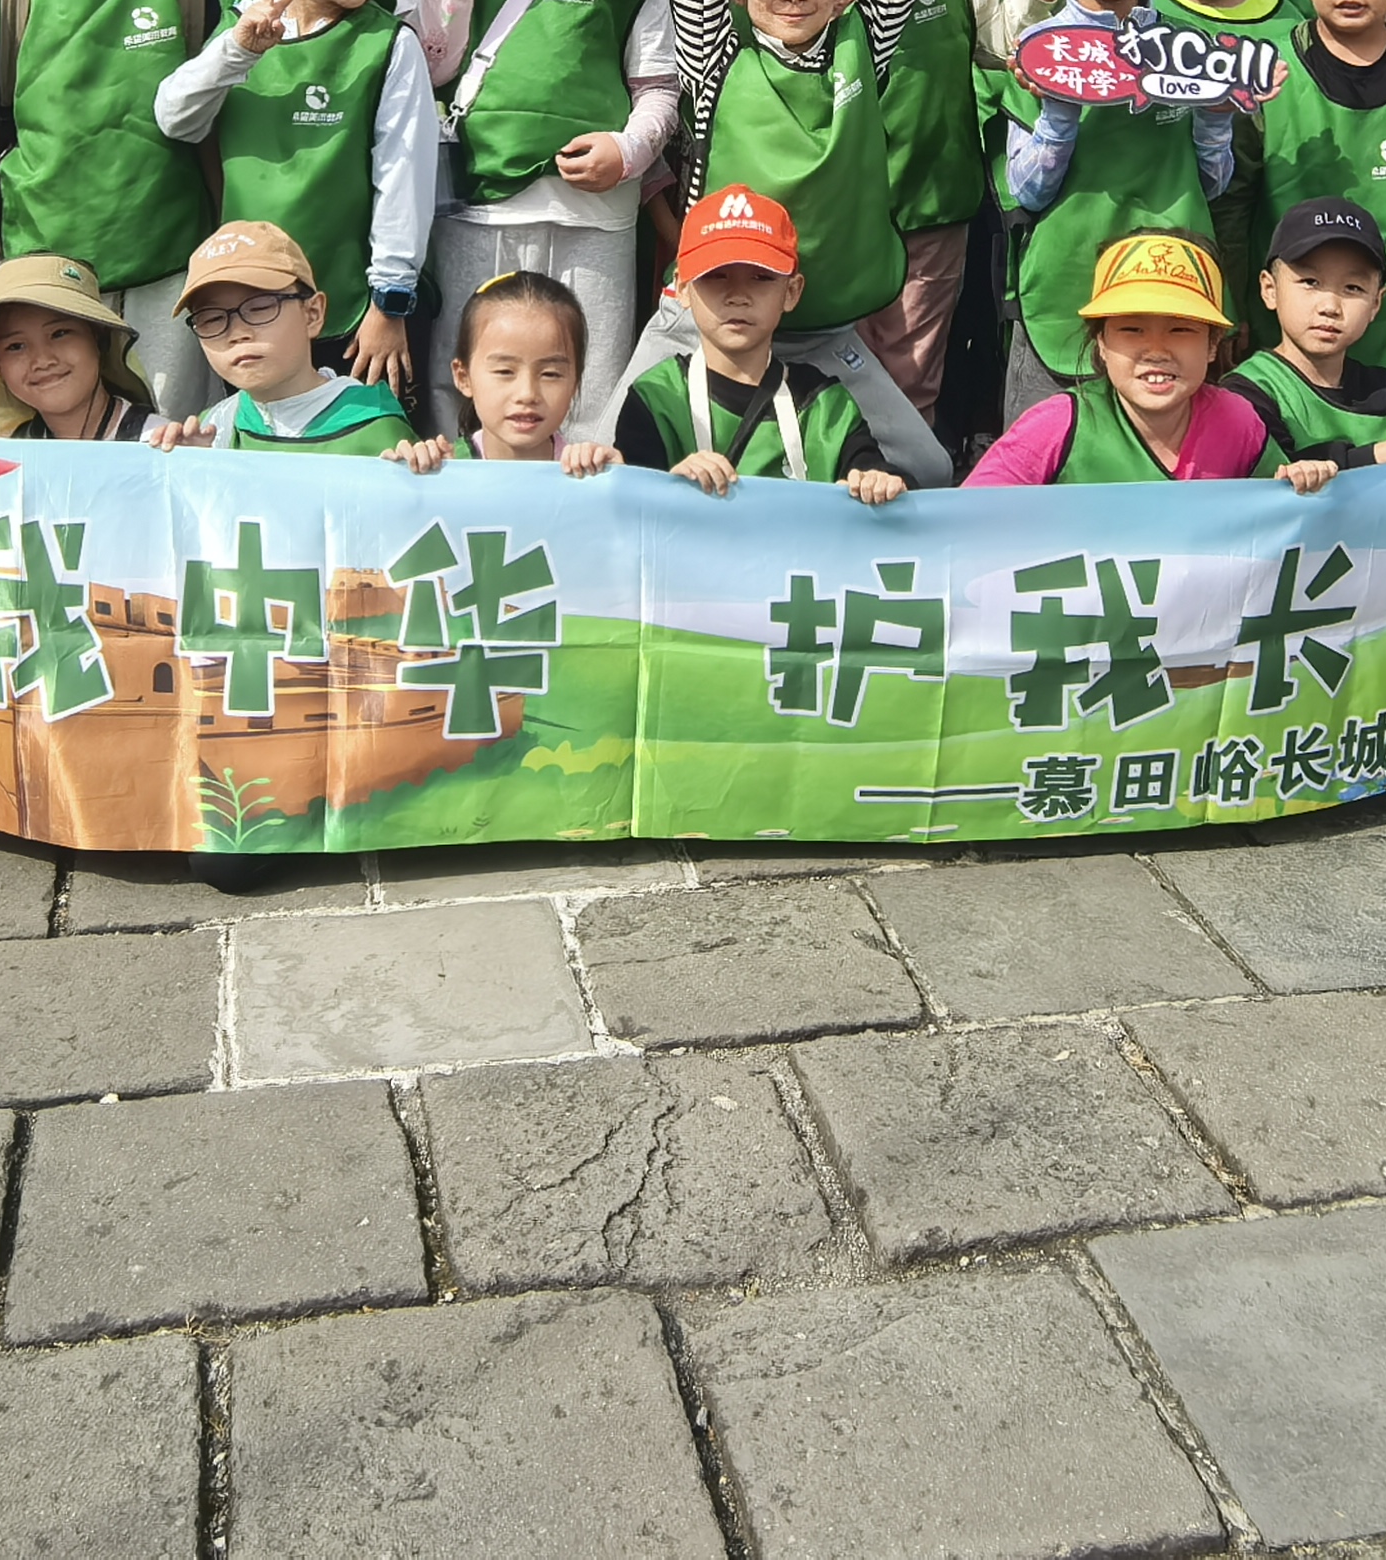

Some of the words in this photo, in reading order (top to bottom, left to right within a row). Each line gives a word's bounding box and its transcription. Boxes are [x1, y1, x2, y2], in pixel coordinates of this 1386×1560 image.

[1044, 34, 1117, 70] 长城
[1117, 20, 1275, 89] 打Call
[1159, 78, 1201, 96] love
